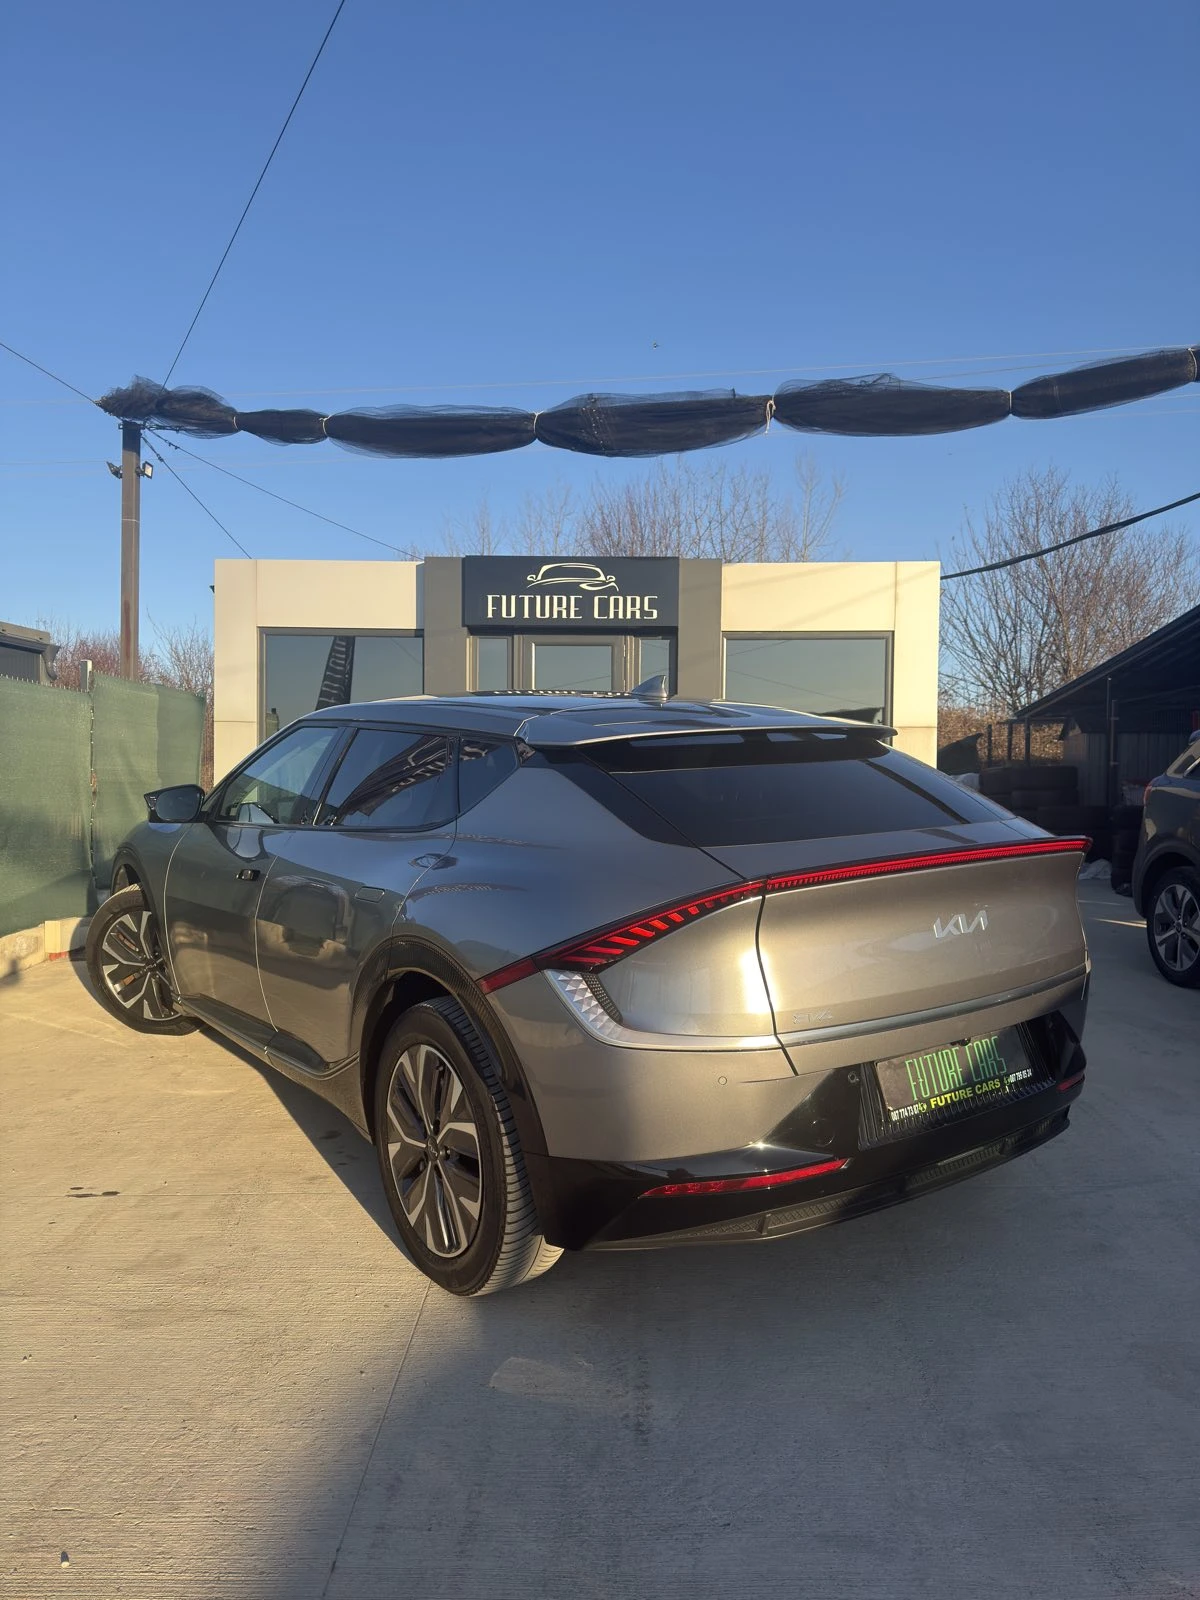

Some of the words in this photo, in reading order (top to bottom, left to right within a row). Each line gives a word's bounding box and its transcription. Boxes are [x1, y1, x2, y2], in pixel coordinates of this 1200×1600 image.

[486, 594, 583, 619] FUTURE
[593, 595, 658, 620] CARS
[933, 910, 989, 938] KIA
[905, 1047, 967, 1101] FUTURE
[965, 1036, 1007, 1081] CARS
[930, 1088, 974, 1108] FUTURE
[975, 1079, 1001, 1095] CARS
